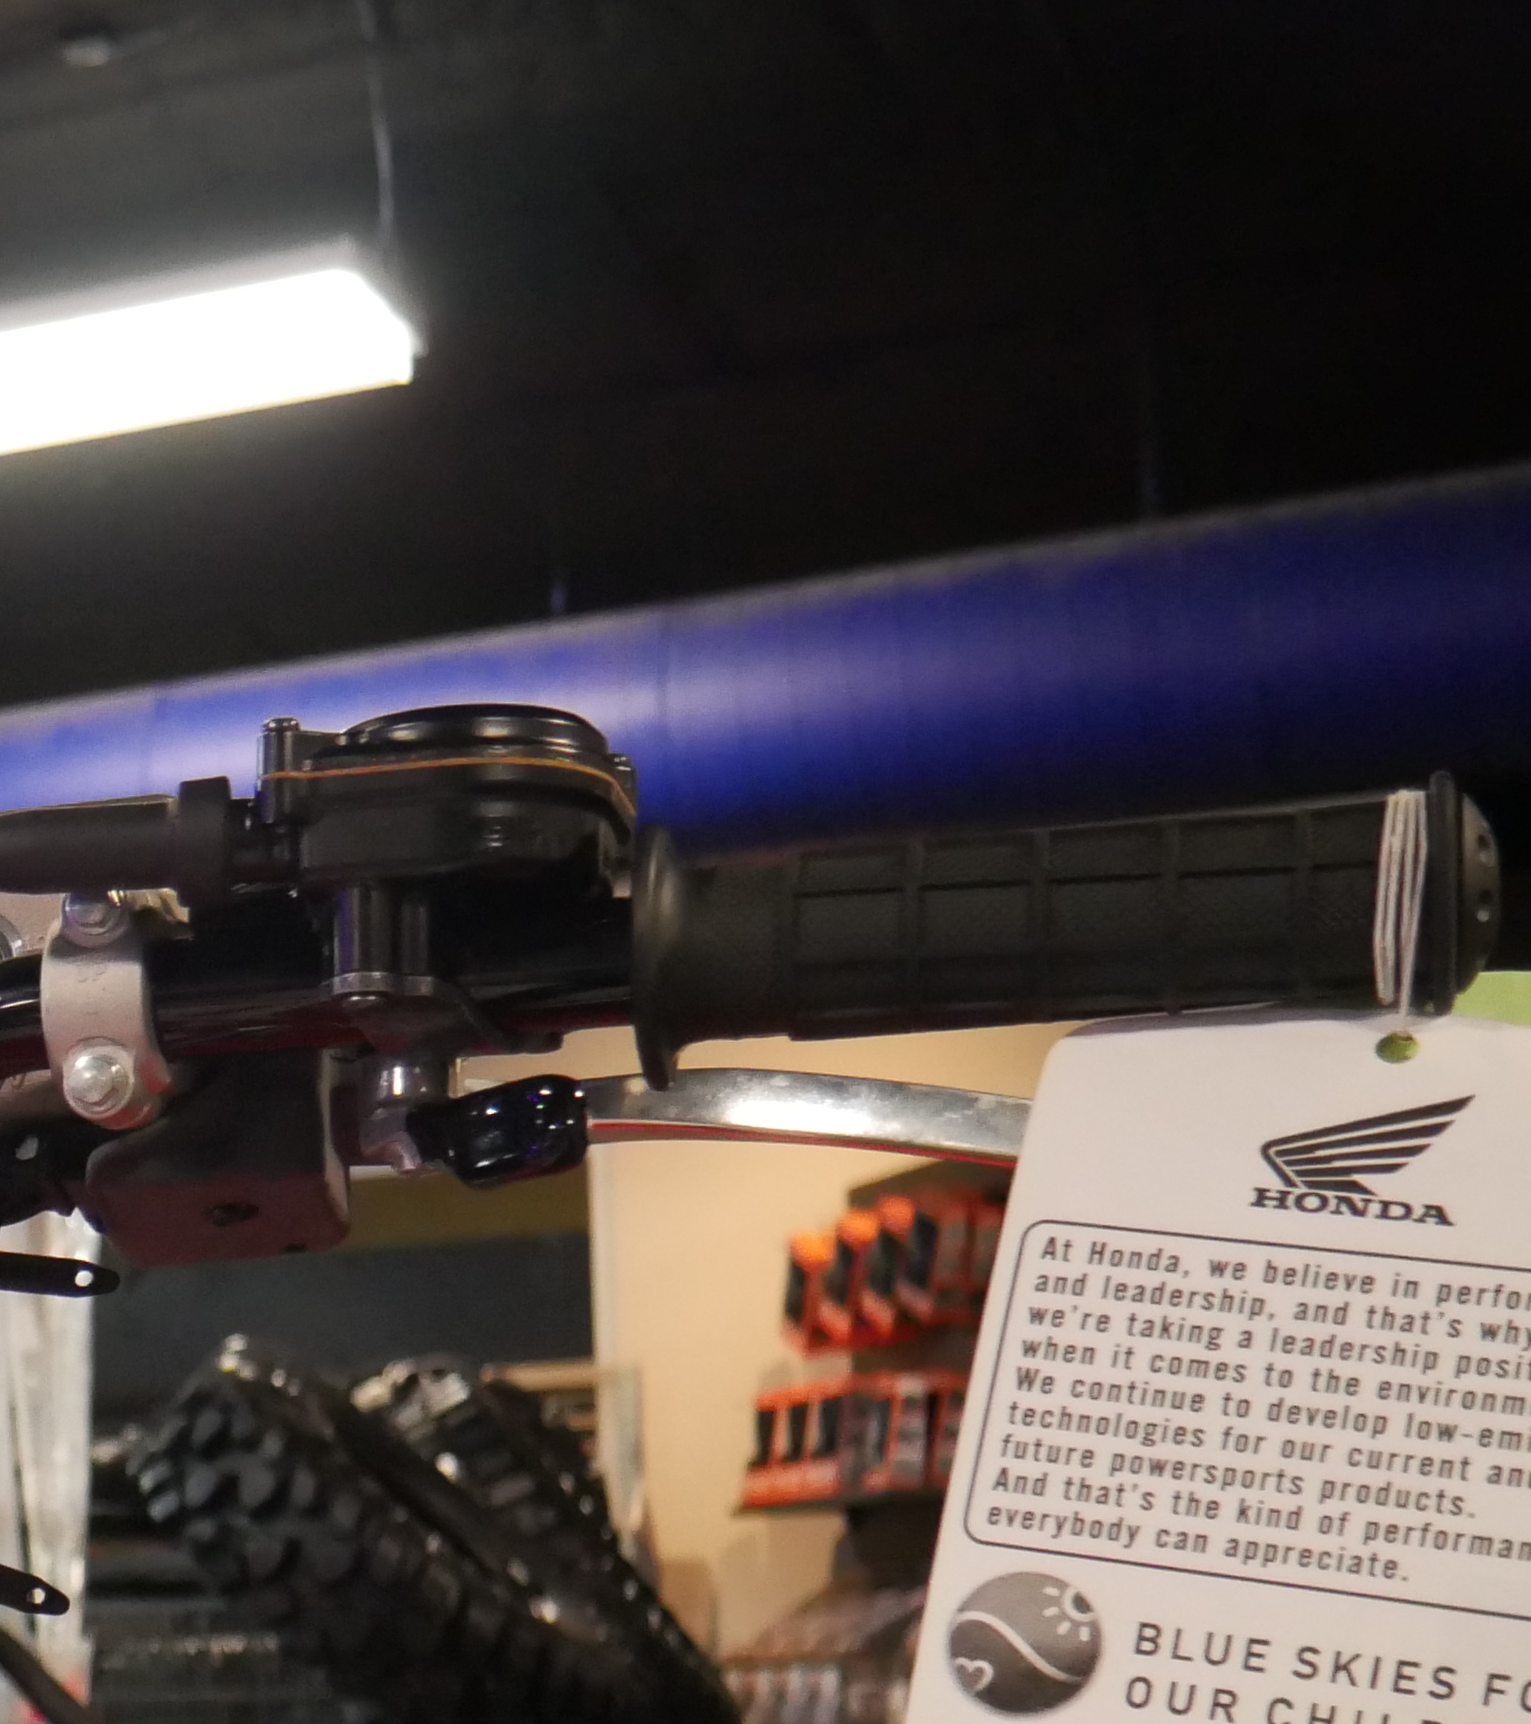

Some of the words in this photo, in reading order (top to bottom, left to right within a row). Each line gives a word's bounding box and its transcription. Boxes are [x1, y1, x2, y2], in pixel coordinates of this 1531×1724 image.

[1250, 1186, 1456, 1227] HONDA
[1040, 1236, 1073, 1263] At
[1087, 1241, 1190, 1278] Honda,
[1208, 1259, 1248, 1281] we
[1262, 1259, 1377, 1295] believe
[1391, 1273, 1420, 1300] in
[1028, 1304, 1111, 1333] we're
[1127, 1312, 1225, 1351] taking
[1237, 1329, 1254, 1349] a
[1269, 1327, 1440, 1375] leadership
[1034, 1273, 1088, 1297] and
[1101, 1275, 1275, 1321] leadership,
[1293, 1301, 1350, 1326] and
[1366, 1305, 1464, 1339] that's
[1016, 1366, 1056, 1395] We
[1070, 1379, 1206, 1413] continue
[1221, 1392, 1251, 1419] to
[1267, 1397, 1389, 1438] develop
[1021, 1336, 1096, 1366] when
[1111, 1344, 1135, 1371] it
[1149, 1354, 1248, 1384] comes
[1264, 1362, 1294, 1389] to
[1311, 1367, 1361, 1397] the
[1376, 1380, 1531, 1416] environm
[1001, 1433, 1095, 1469] future
[1109, 1452, 1305, 1496] powersports
[1318, 1479, 1475, 1519] products.
[1009, 1401, 1206, 1448] technologies
[1221, 1425, 1267, 1455] for
[1280, 1438, 1333, 1463] our
[1347, 1447, 1472, 1482] current
[992, 1466, 1049, 1497] And
[1063, 1476, 1156, 1512] that's
[1171, 1490, 1221, 1520] the
[1235, 1497, 1304, 1531] kind
[1317, 1511, 1351, 1537] of
[987, 1506, 1141, 1549] everybody
[1155, 1528, 1209, 1554] can
[1223, 1537, 1408, 1582] appreciate.
[1134, 1622, 1271, 1674] BLUE
[1292, 1645, 1457, 1701] SKIES
[1125, 1676, 1238, 1724] OUR
